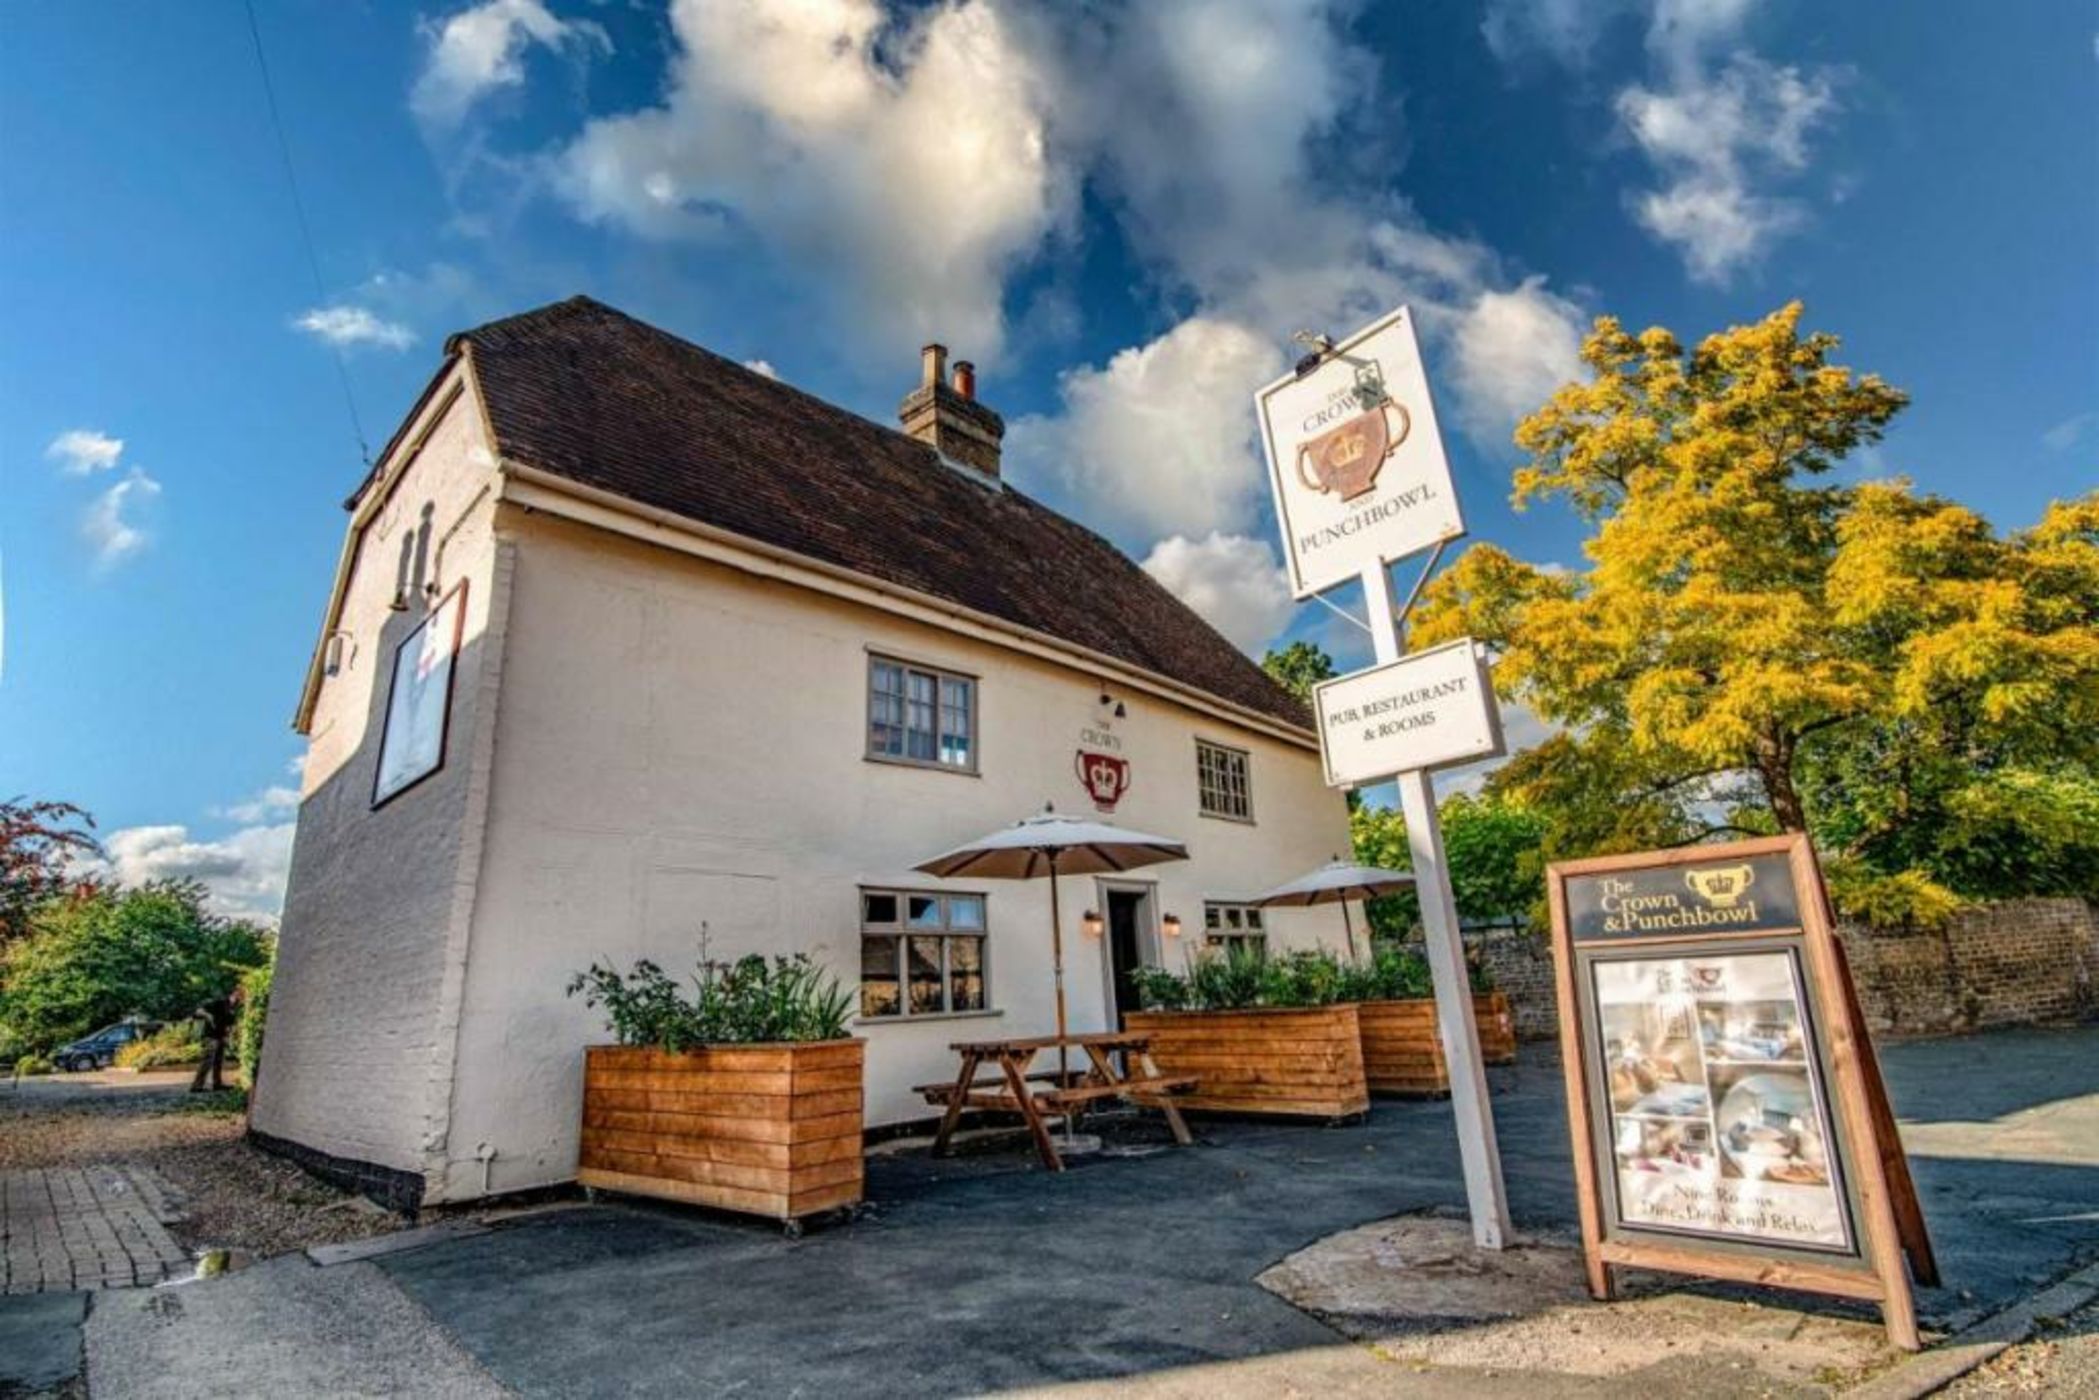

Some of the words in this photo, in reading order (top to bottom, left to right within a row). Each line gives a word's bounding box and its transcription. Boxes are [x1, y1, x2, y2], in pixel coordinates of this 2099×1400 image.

[1303, 392, 1364, 433] CROW
[1300, 483, 1437, 555] PUNCHBOWL
[1362, 676, 1468, 719] RESTAURANT
[1363, 728, 1376, 741] &
[1378, 710, 1436, 738] ROOMS
[1081, 728, 1121, 752] CROWN
[1603, 880, 1633, 896] The
[1601, 894, 1678, 913] Crown
[1674, 1184, 1711, 1201] Nin
[1717, 1187, 1773, 1207] Roms
